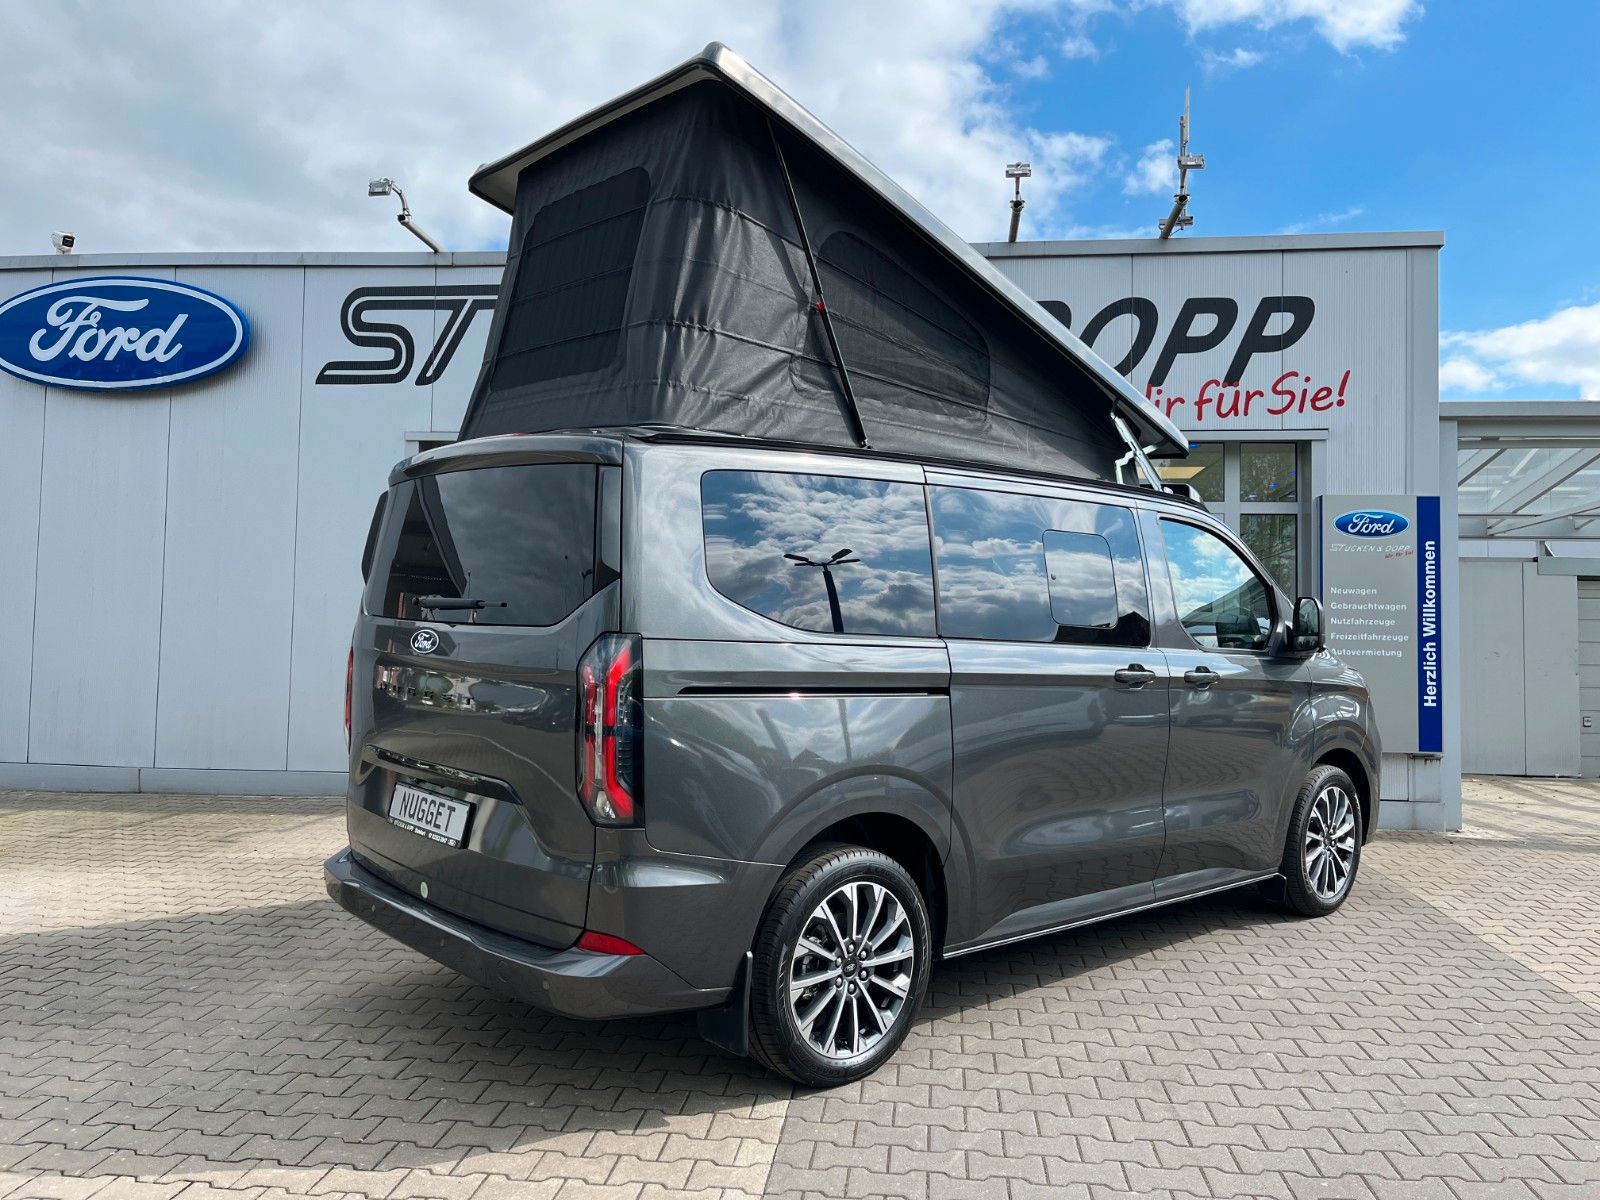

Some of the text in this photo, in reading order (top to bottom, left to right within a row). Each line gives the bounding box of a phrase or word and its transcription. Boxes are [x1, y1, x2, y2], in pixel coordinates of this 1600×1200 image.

[29, 295, 189, 362] Ford
[1194, 379, 1265, 421] für
[1267, 370, 1351, 415] Sie!
[1347, 513, 1395, 534] Ford
[1330, 586, 1377, 595] Neuwagen
[1330, 602, 1407, 611] Gebrauchtwagen
[1330, 617, 1396, 626] Nutzfahrzeuge
[1422, 540, 1437, 707] Herzlich Willkommen
[414, 632, 434, 649] Ford
[1330, 632, 1409, 642] Freizeitfahrzeuge
[1331, 648, 1402, 657] Autovermietung
[399, 790, 456, 832] NUGGET
